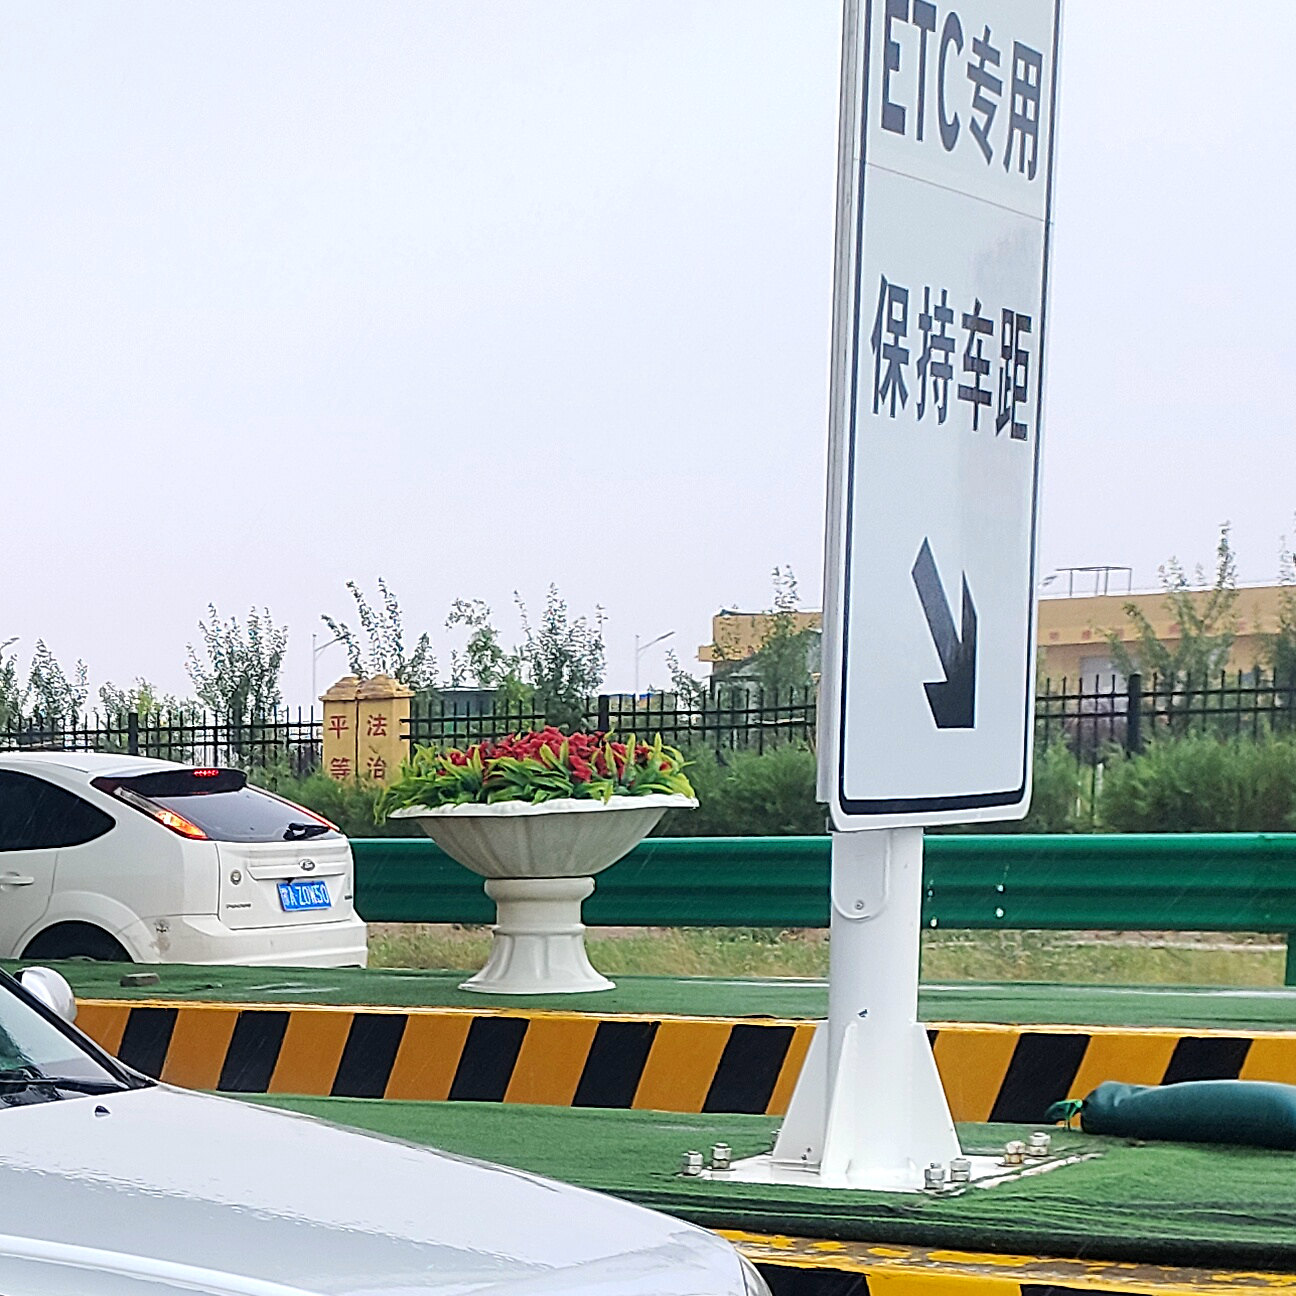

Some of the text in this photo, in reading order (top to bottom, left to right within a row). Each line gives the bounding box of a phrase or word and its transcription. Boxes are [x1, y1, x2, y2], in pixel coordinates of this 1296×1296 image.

[881, 0, 1043, 181] ETC专用
[870, 273, 1032, 441] 保持车距
[367, 713, 387, 779] 法治
